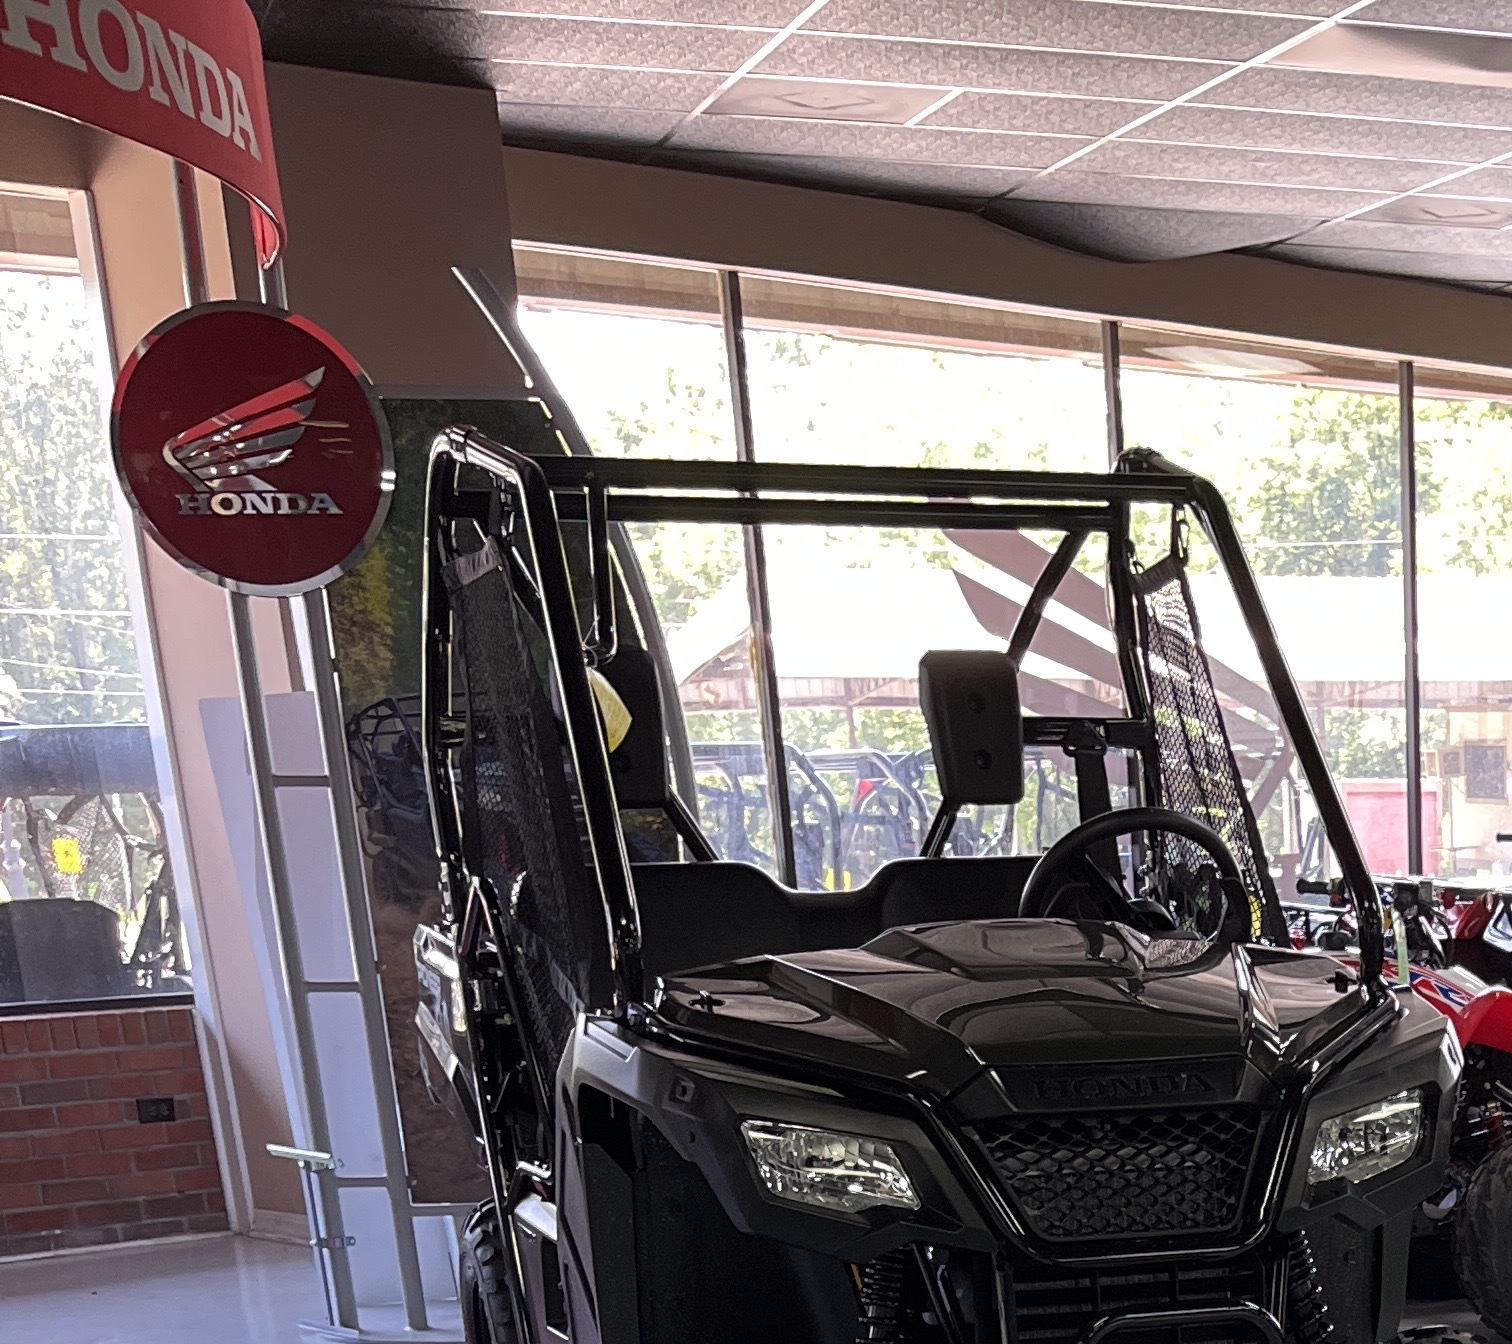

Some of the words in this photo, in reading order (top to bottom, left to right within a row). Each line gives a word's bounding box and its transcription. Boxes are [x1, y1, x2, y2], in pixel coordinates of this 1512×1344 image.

[1, 0, 262, 162] HONDA
[175, 492, 344, 516] HONDA
[1033, 1072, 1216, 1099] HONDA
